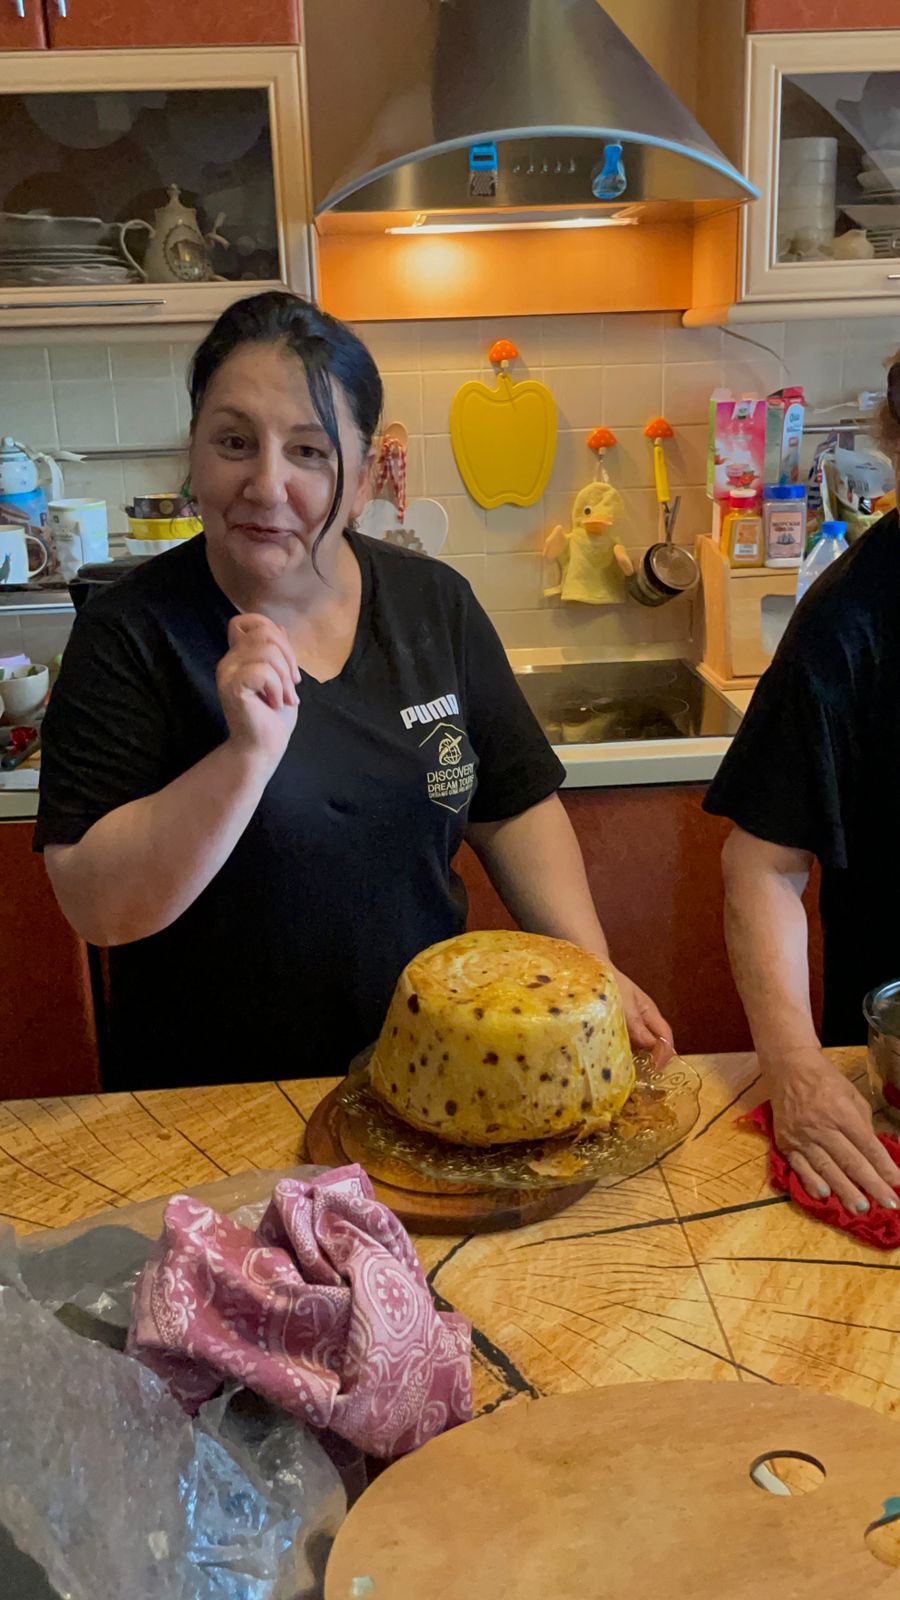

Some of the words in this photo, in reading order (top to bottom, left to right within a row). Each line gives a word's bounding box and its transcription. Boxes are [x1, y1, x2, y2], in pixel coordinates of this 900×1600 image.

[400, 693, 459, 729] PUMA
[427, 762, 474, 783] DISCOVERY
[427, 780, 458, 792] DREAM
